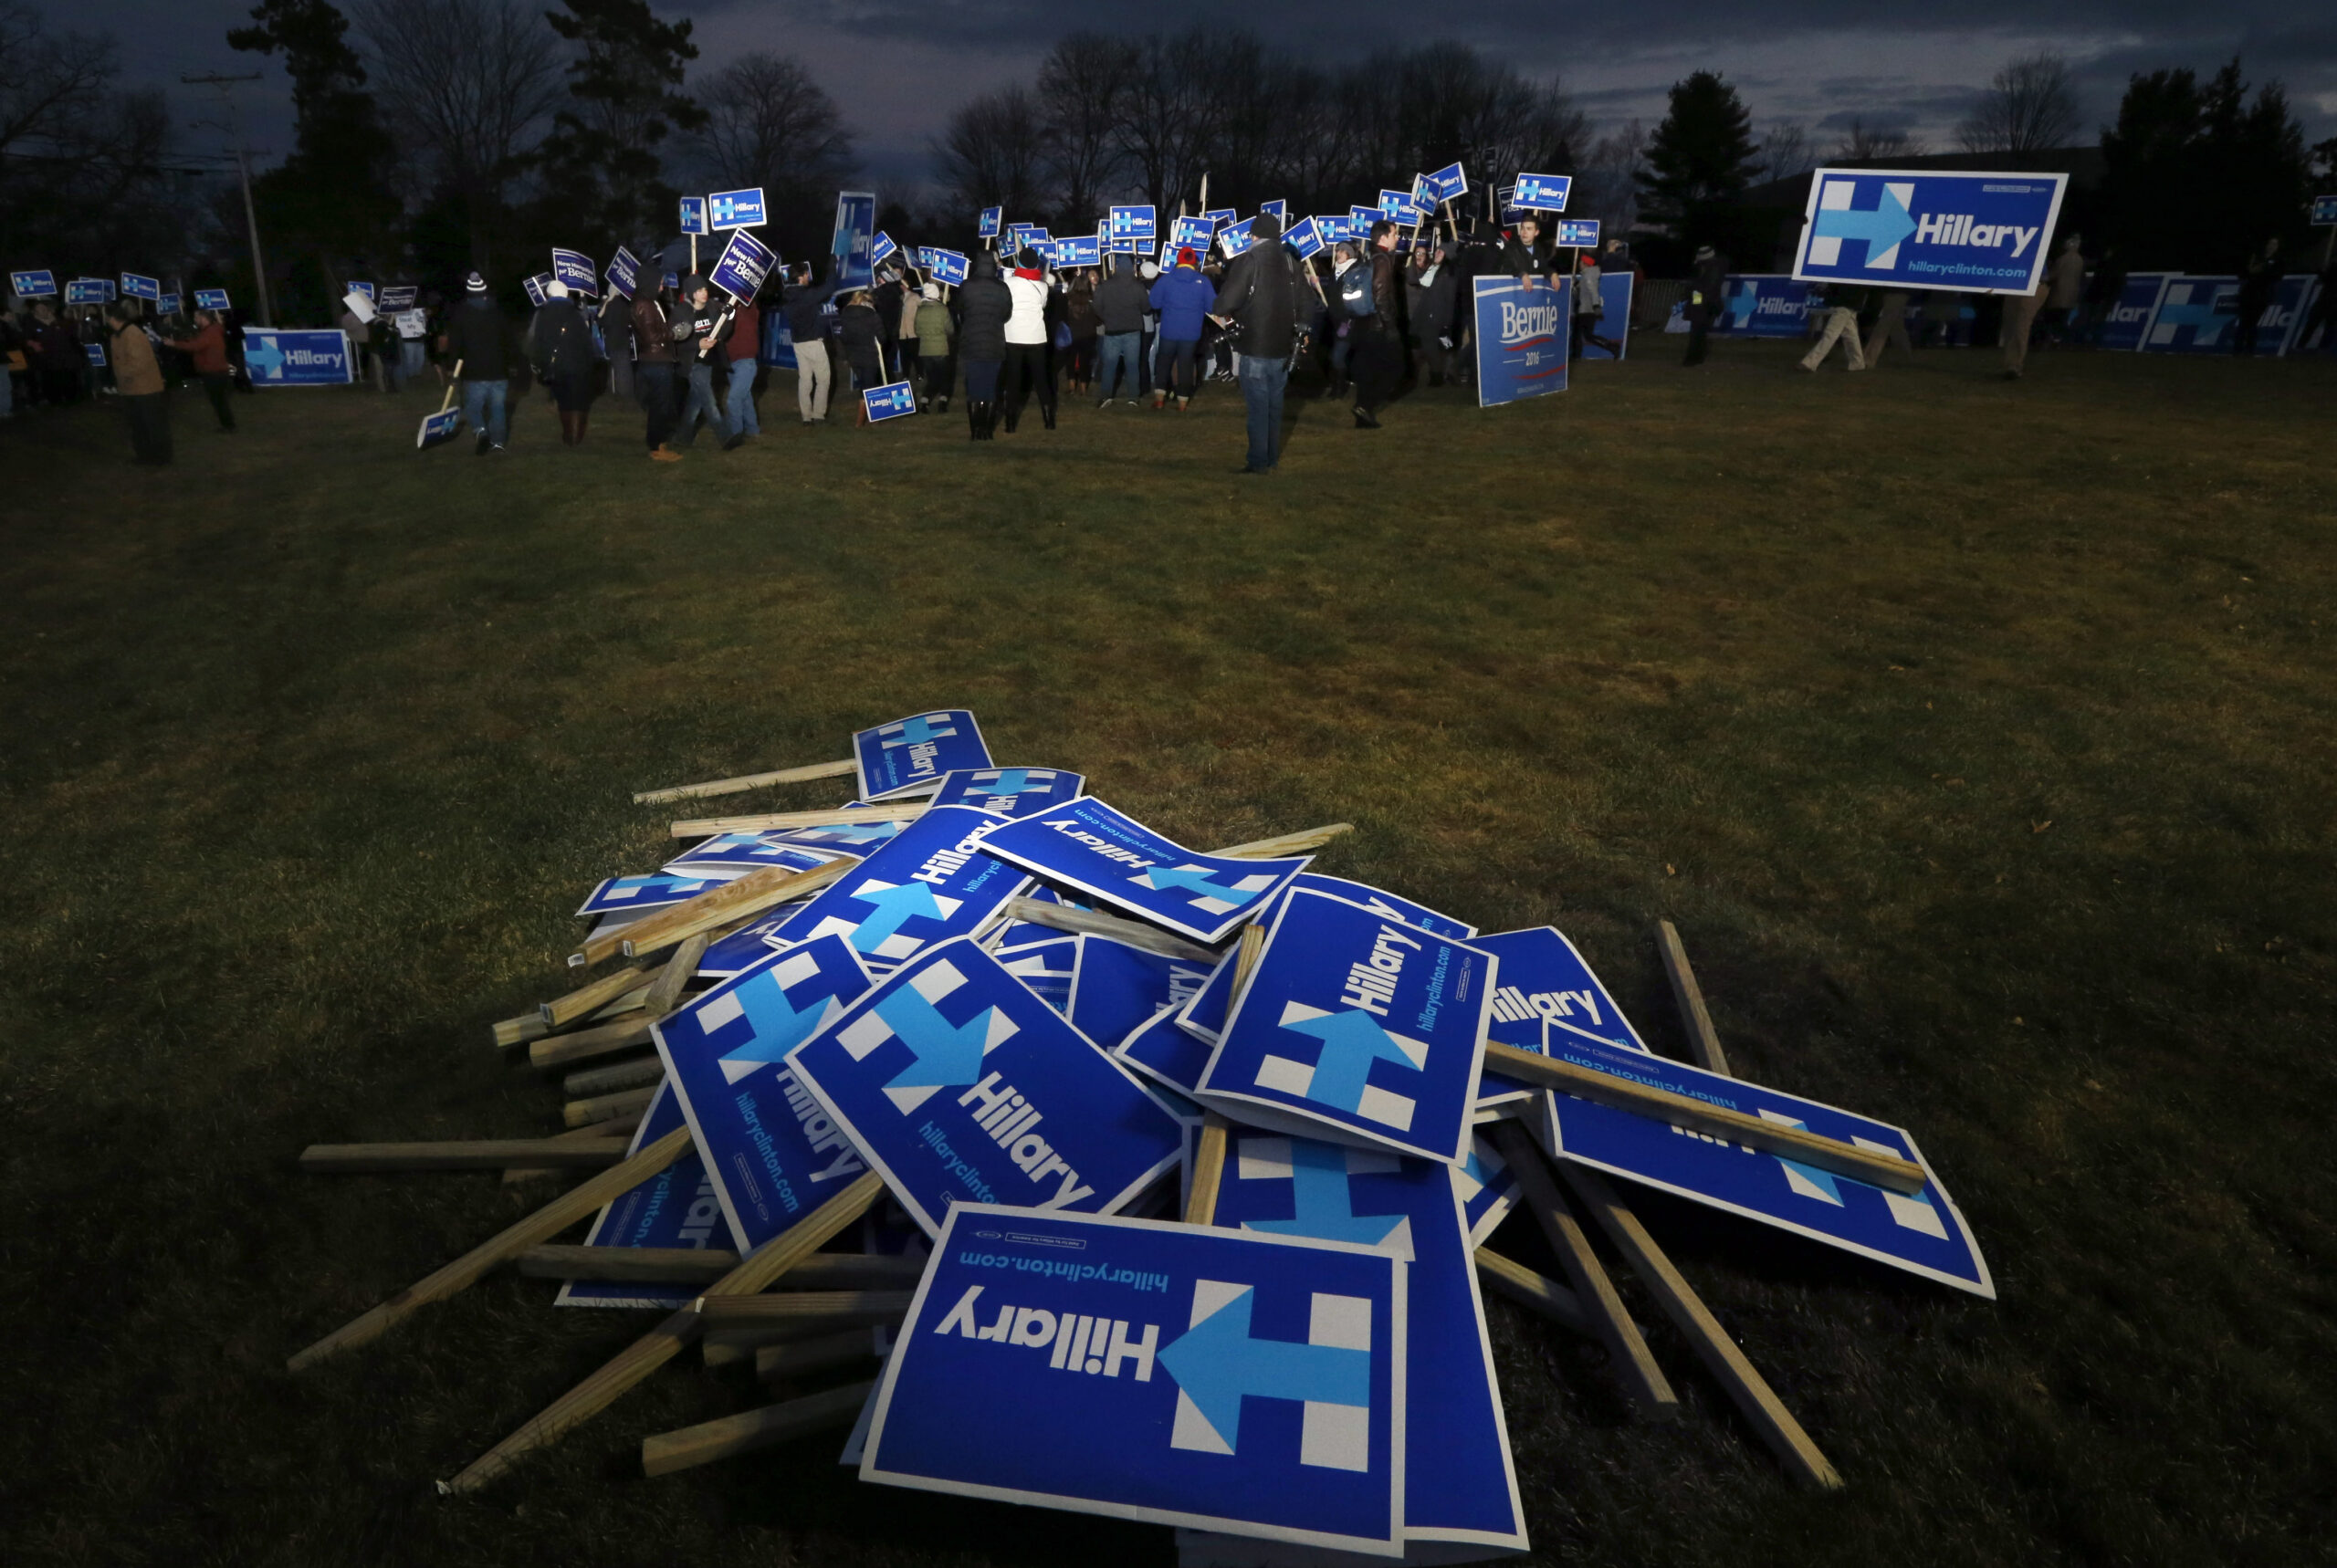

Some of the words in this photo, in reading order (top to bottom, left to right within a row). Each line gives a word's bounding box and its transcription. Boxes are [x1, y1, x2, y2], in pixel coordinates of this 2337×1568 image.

[735, 203, 760, 212] Hillary
[1539, 188, 1565, 199] Hillary
[1132, 218, 1153, 226] Hillary
[1296, 232, 1315, 246] Hillary
[1914, 213, 2039, 257] Hillary
[730, 246, 748, 259] New
[1076, 247, 1098, 256] Hillary
[1908, 260, 2028, 277] hillaryclinton.com
[567, 267, 595, 285] Bernie
[724, 257, 736, 267] for
[734, 260, 761, 288] Bernie
[1500, 296, 1558, 339] Bernie
[1756, 297, 1808, 320] Hillary
[285, 350, 342, 368] Hillary
[1525, 351, 1540, 366] 2016
[908, 742, 937, 779] Hillary
[1042, 820, 1157, 870] Hillary
[1074, 809, 1177, 862] hillaryclinton.com
[1340, 925, 1421, 1017] Hillary
[1416, 946, 1451, 1032] hillaryclinton.com
[1491, 986, 1602, 1026] illary
[1564, 1052, 1738, 1112] hillaryclinton.com
[734, 1092, 800, 1214] hillaryclinton.com
[957, 1071, 1095, 1210] Hillary
[918, 1121, 998, 1205] hillaryclinto
[959, 1251, 1169, 1292] hillaryclinton.com
[933, 1285, 1159, 1382] Hillary
